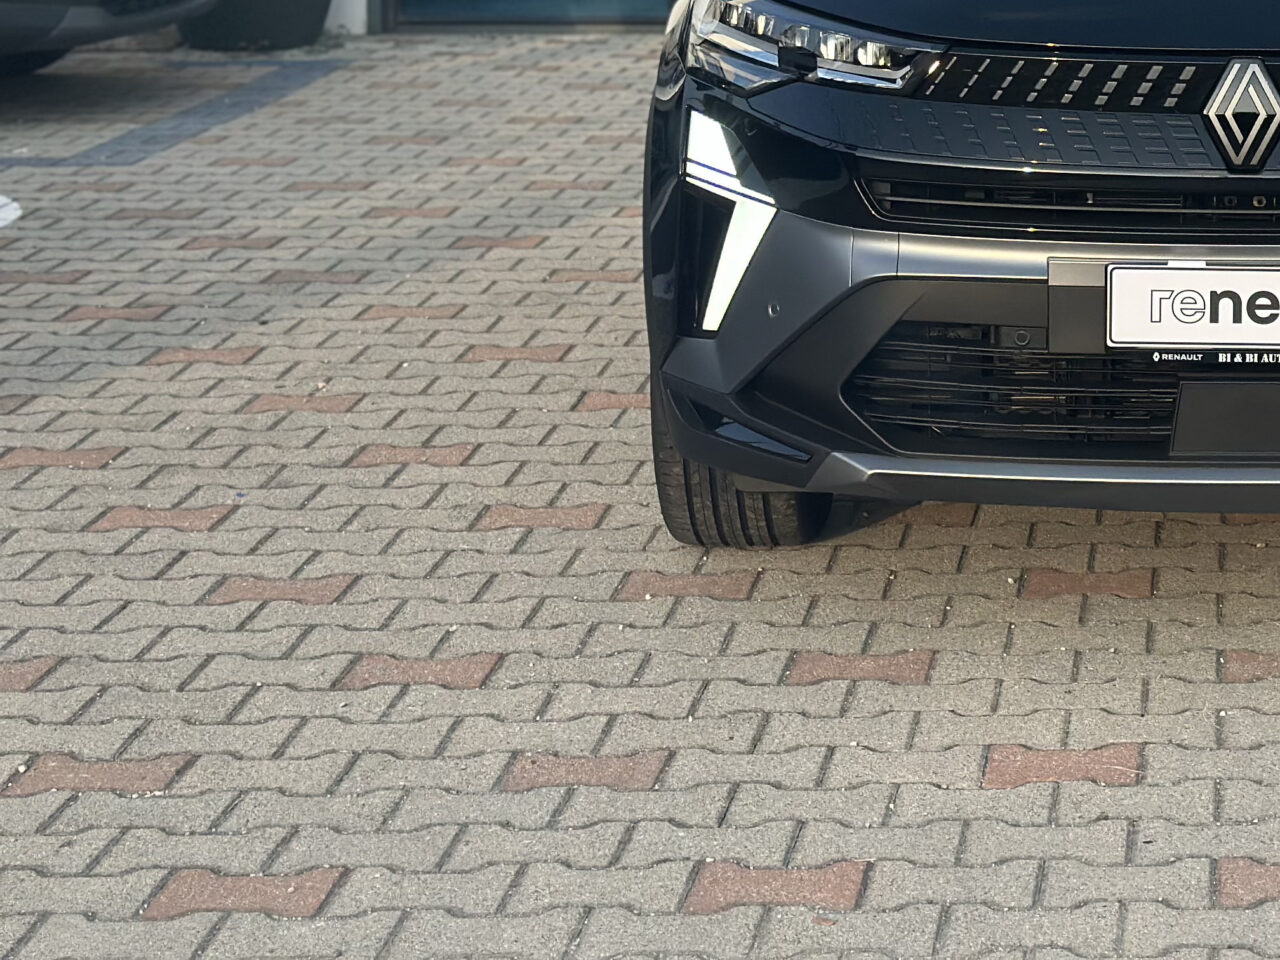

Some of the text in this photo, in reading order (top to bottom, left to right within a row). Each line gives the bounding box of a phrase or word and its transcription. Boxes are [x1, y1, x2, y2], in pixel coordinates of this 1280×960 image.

[1161, 353, 1203, 361] RENAULT
[1218, 353, 1231, 363] BI
[1234, 353, 1243, 363] &
[1245, 353, 1259, 363] BI
